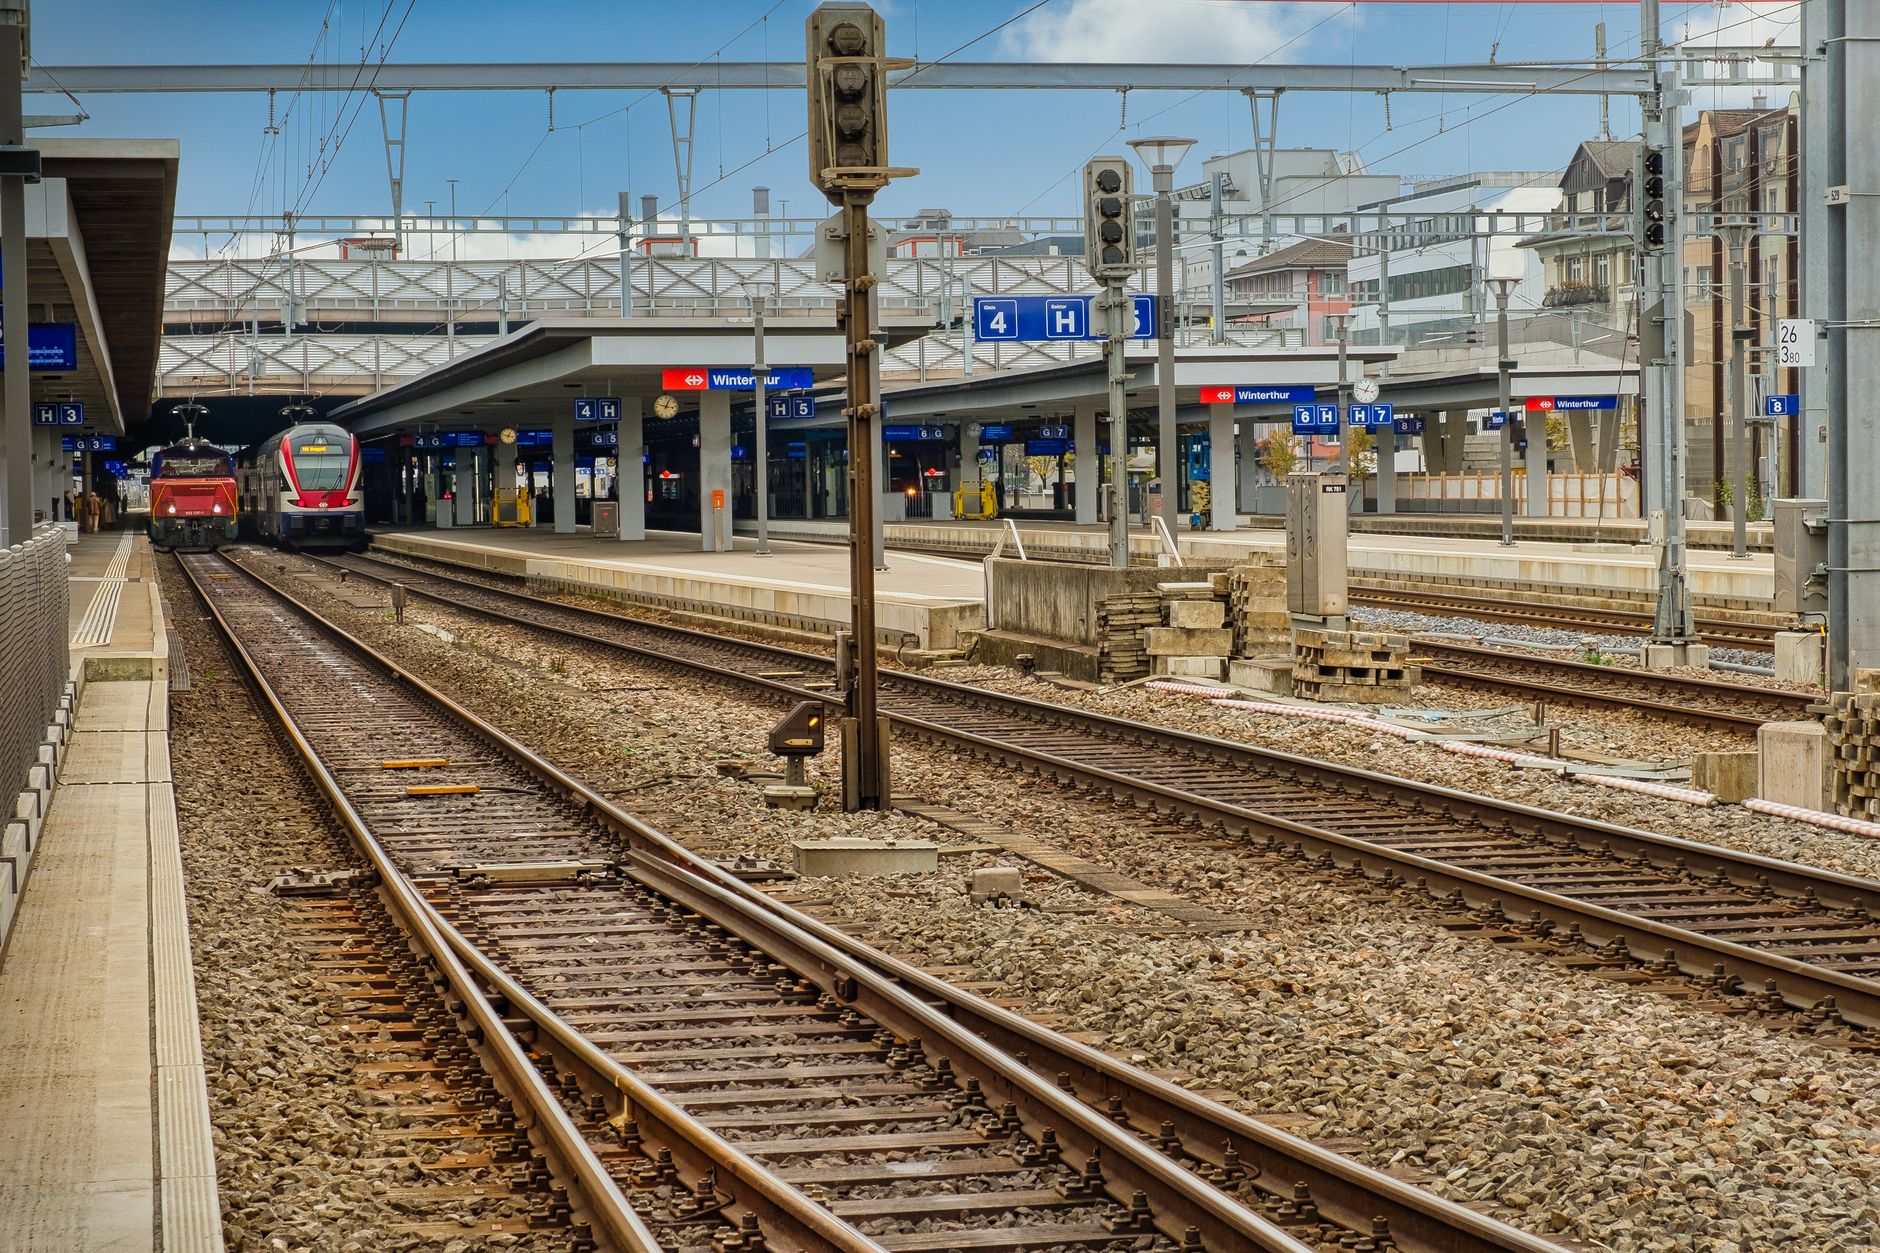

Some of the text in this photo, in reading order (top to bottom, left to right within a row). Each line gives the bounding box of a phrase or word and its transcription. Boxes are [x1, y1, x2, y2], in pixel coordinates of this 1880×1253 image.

[989, 310, 1075, 334] 4 H
[1781, 325, 1797, 343] 26
[713, 374, 780, 386] Winterur
[1238, 390, 1290, 400] Winterthur
[775, 403, 808, 416] H 5
[1557, 400, 1600, 408] Winterthur
[1773, 401, 1782, 413] 8
[41, 409, 77, 422] H 3
[581, 405, 615, 417] 4 H
[1301, 410, 1333, 423] 6 H
[1355, 410, 1386, 422] H 7
[1401, 421, 1422, 430] 8 F
[921, 429, 928, 438] 6
[934, 429, 942, 438] G
[1043, 428, 1063, 436] G 7
[76, 440, 85, 449] G
[92, 440, 100, 449] 3
[417, 437, 439, 446] 4 G
[594, 434, 617, 443] G 5
